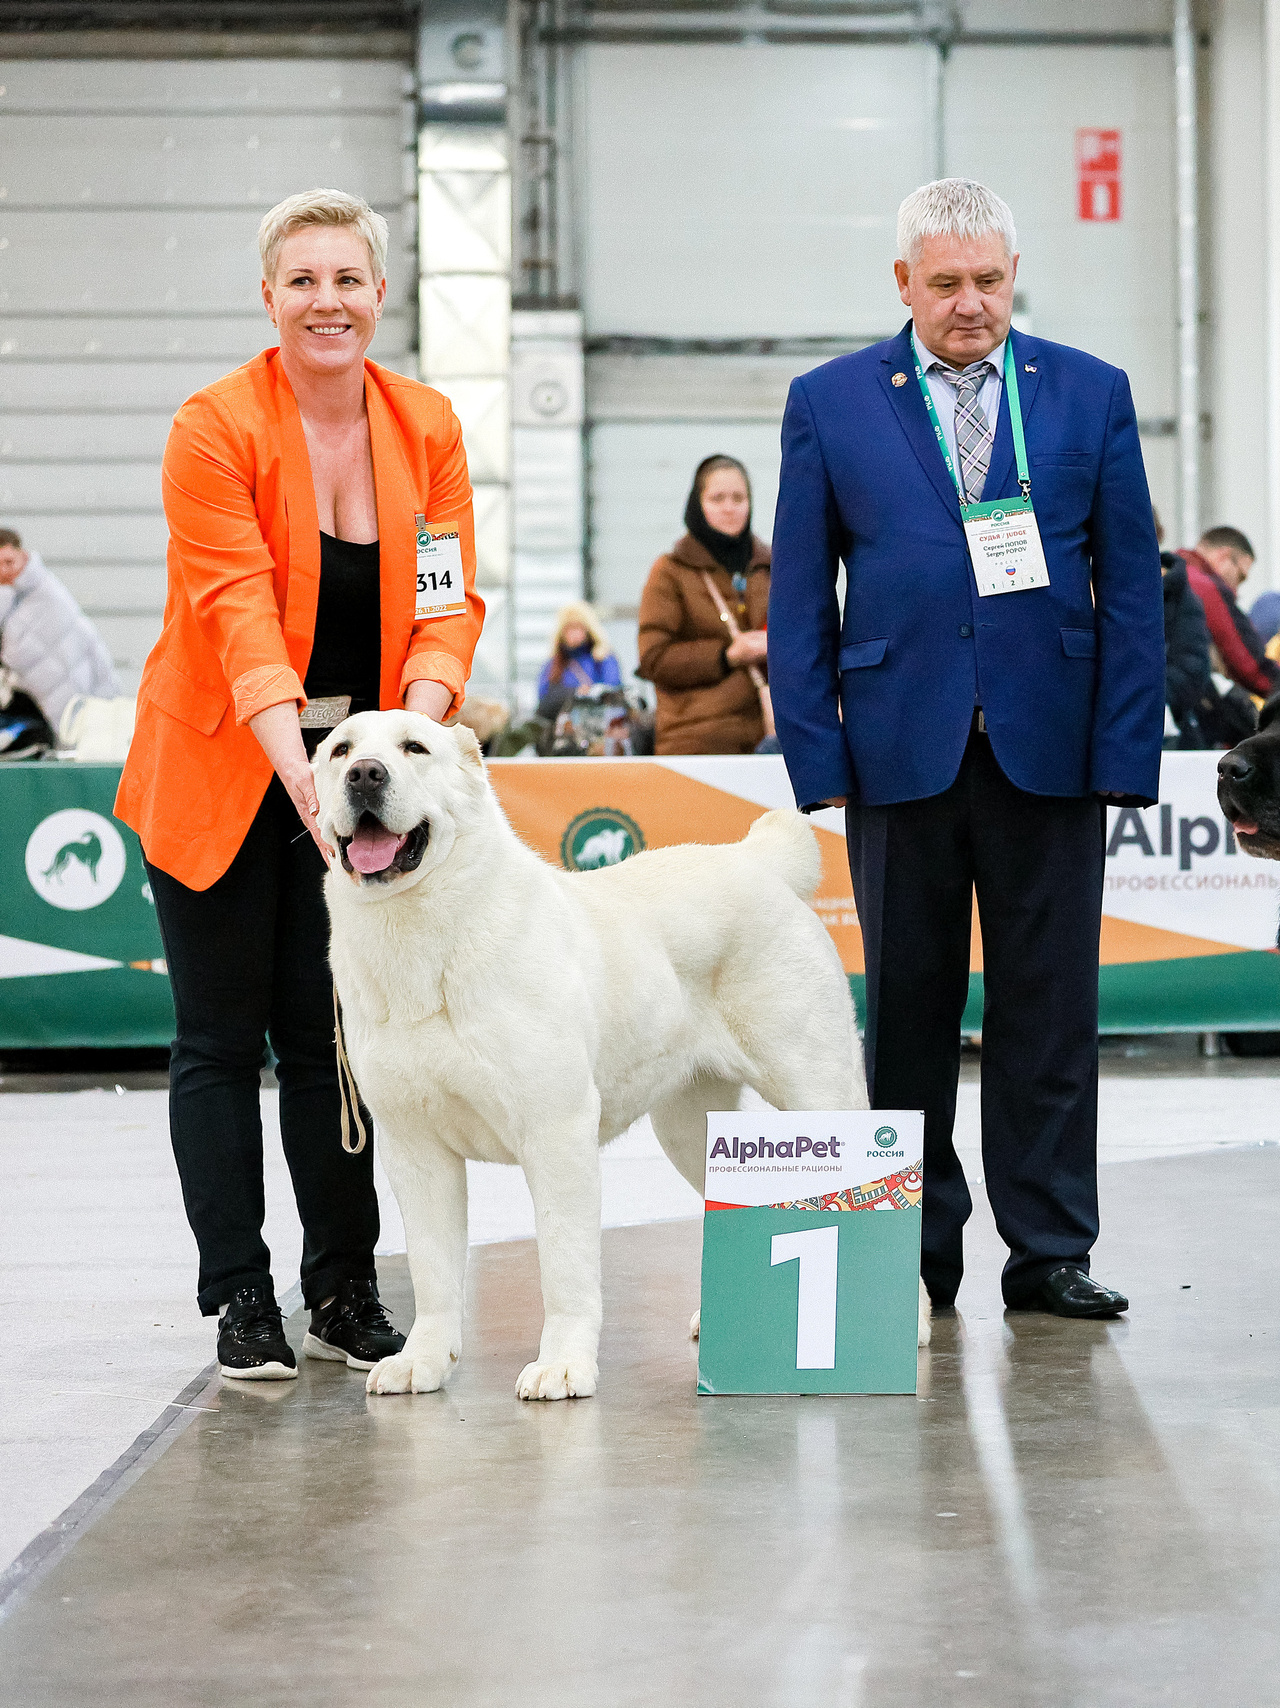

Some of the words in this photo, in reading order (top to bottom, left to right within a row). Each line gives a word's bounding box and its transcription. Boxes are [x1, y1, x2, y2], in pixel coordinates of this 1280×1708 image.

[979, 533, 1001, 542] СУДЬЯ
[1006, 529, 1027, 539] JUDGE
[416, 546, 438, 554] ОССИЯ
[983, 543, 1004, 552] Сергей
[1005, 539, 1028, 548] ПОПОВ
[986, 550, 1005, 558] Sergey
[1006, 546, 1027, 555] POPOV
[416, 570, 453, 593] 314
[709, 1136, 841, 1164] AlphaPet
[866, 1150, 905, 1158] РОССИЯ
[708, 1165, 800, 1173] ПРОФЕССИОНАЛЬНЫЕ
[801, 1164, 843, 1173] РАЦИОНЫ
[770, 1225, 839, 1370] 1
